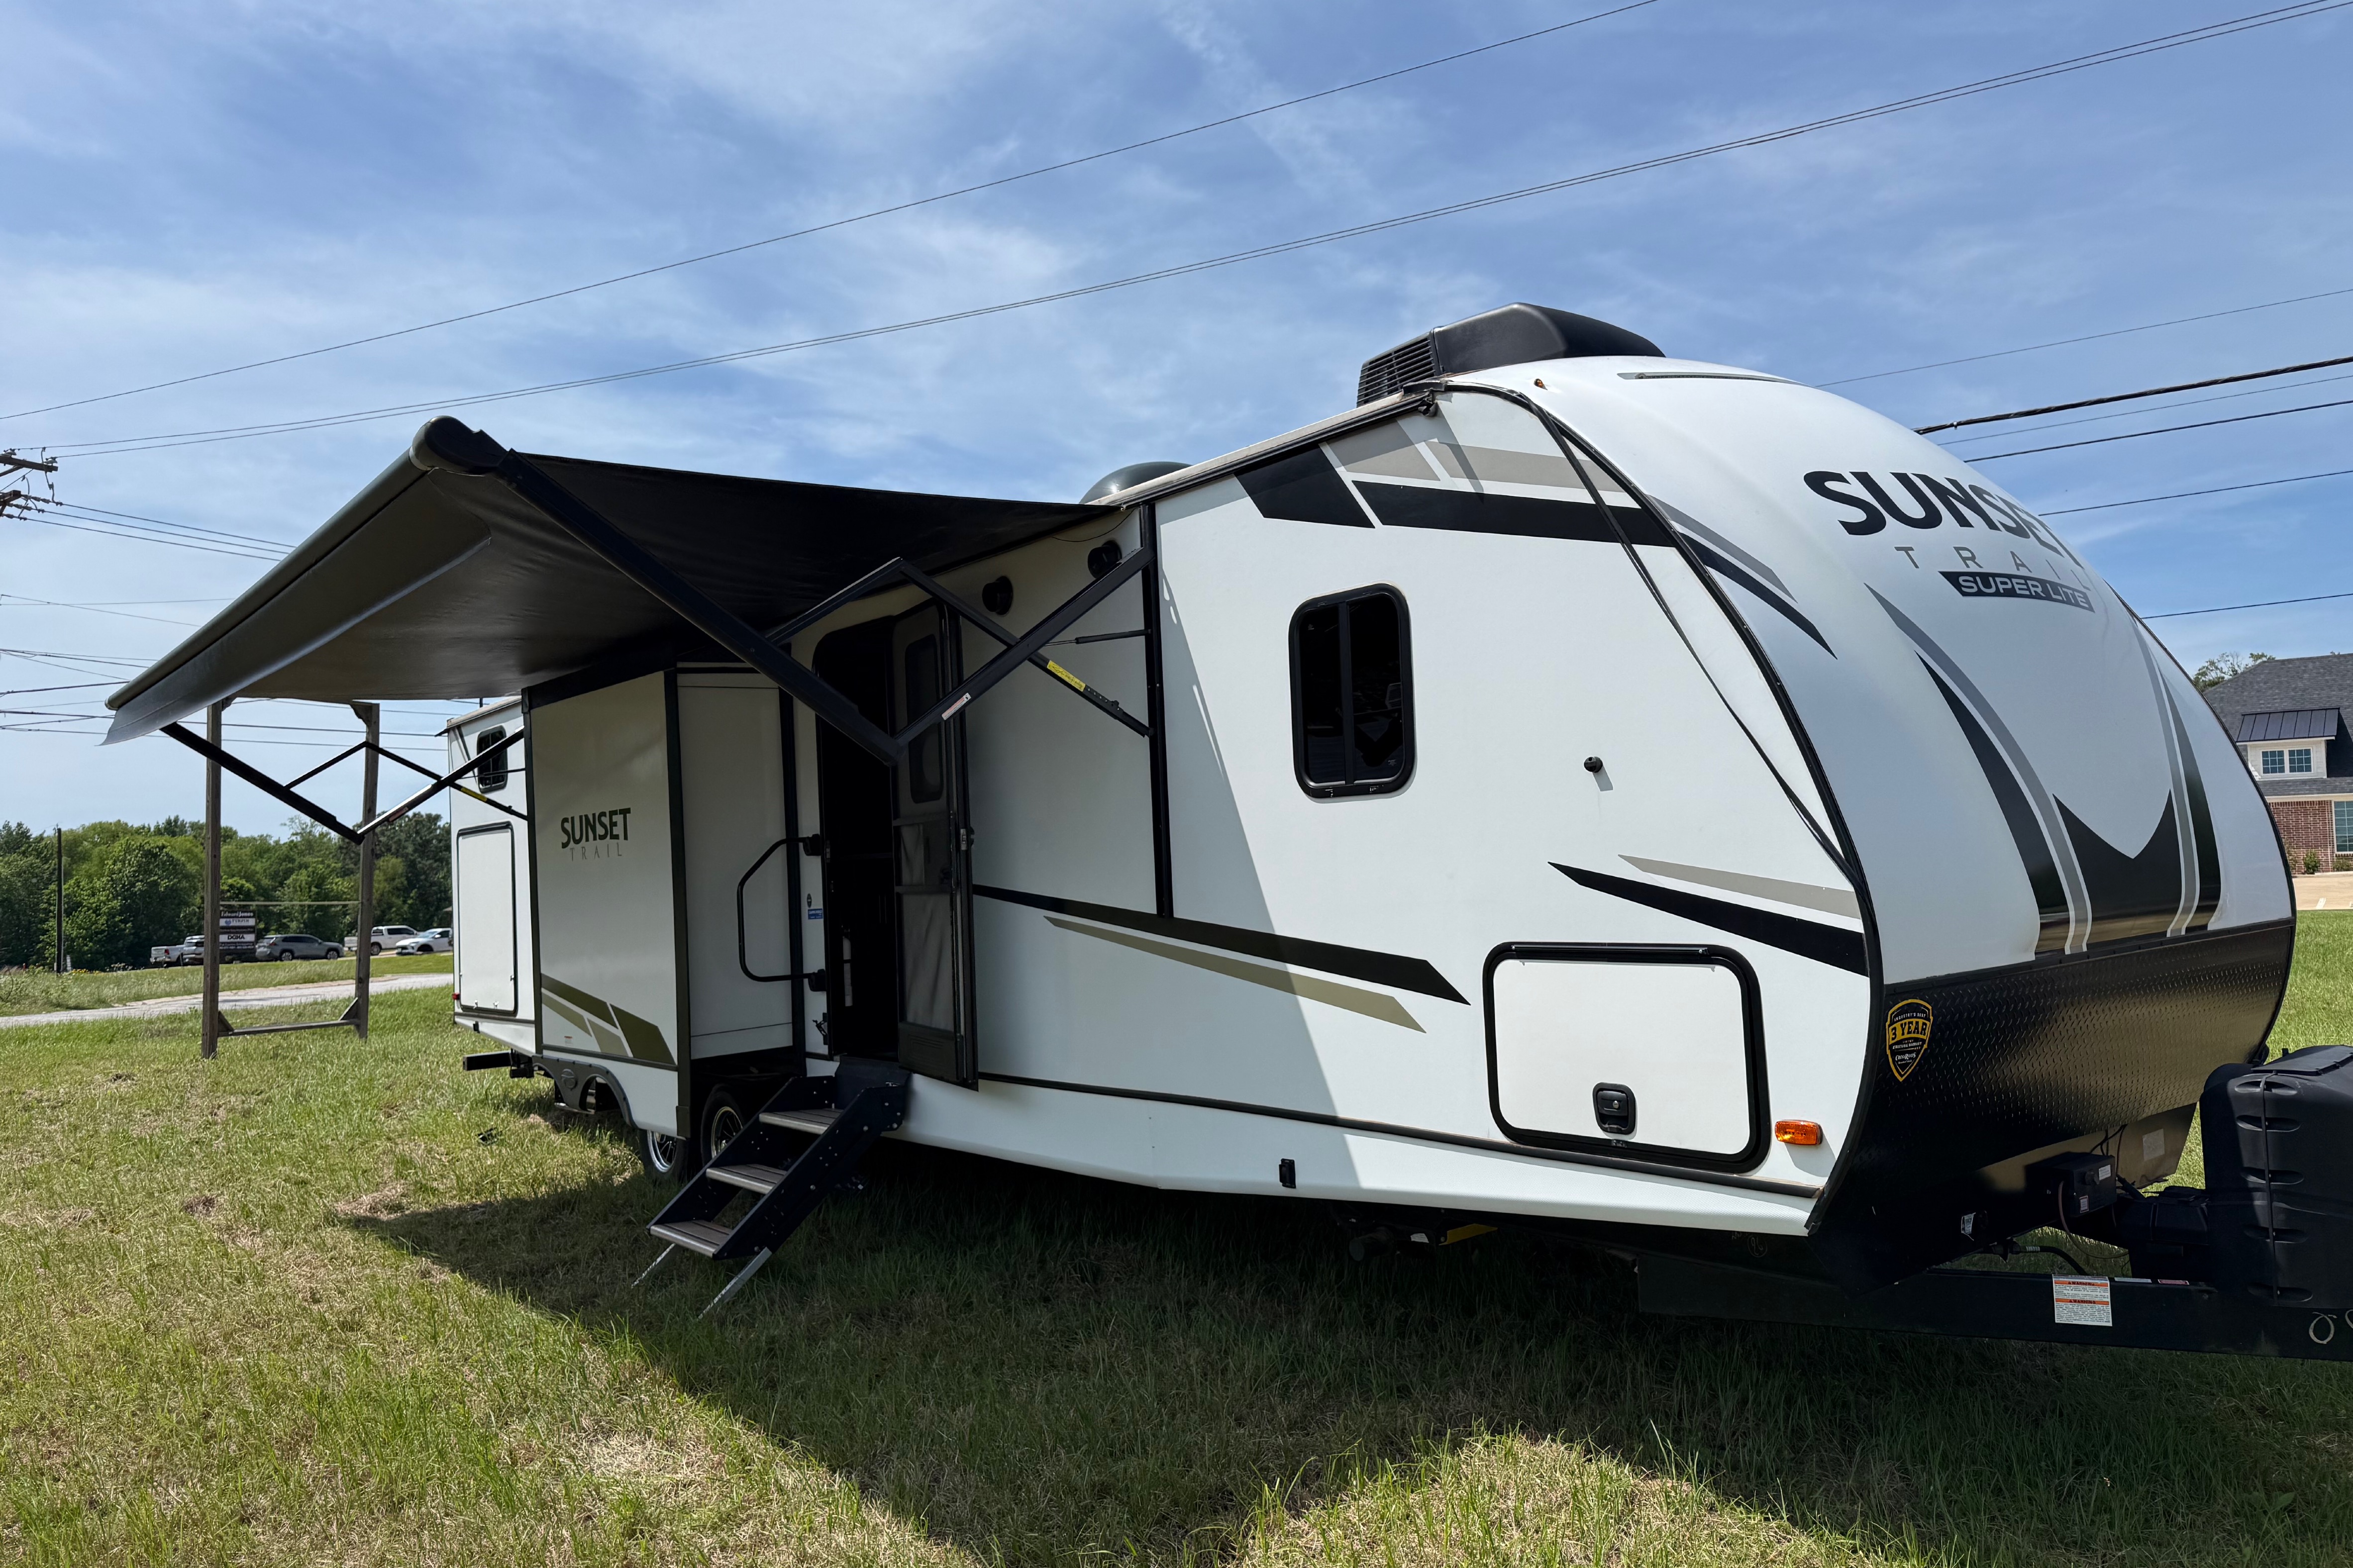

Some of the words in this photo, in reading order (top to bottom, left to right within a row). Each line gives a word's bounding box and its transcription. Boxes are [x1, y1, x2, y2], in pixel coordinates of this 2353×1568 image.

[1804, 471, 2085, 570] SUNSET
[1895, 546, 2091, 591] TRAIL
[1958, 576, 2046, 597] SUPER
[2046, 583, 2089, 608] LITE
[561, 807, 631, 849] SUNSET
[570, 842, 622, 861] TRAIL
[1891, 1026, 1897, 1041] 3
[1900, 1021, 1927, 1036] YEAR
